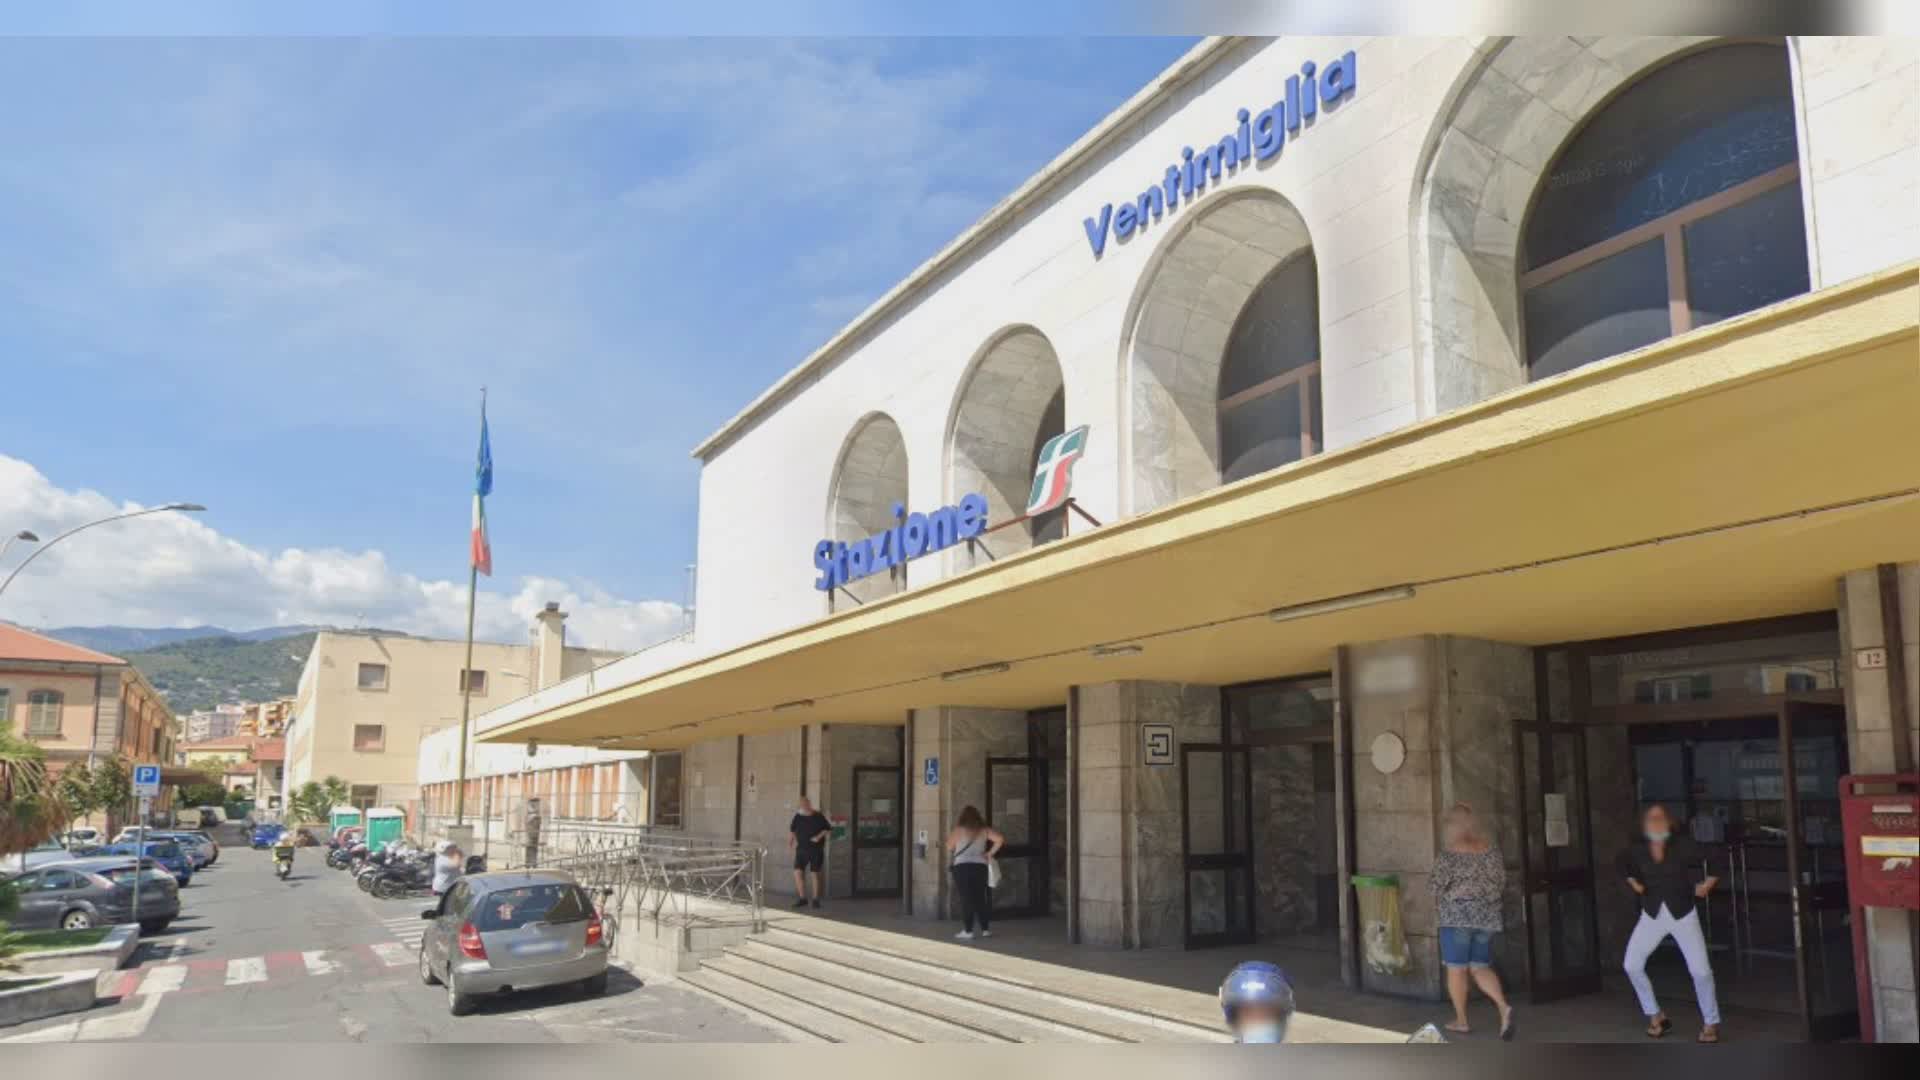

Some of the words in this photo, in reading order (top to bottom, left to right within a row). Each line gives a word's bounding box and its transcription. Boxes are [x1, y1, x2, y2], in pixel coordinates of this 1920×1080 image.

[1083, 50, 1356, 259] Ventimiglia
[814, 493, 988, 591] Stazione
[1863, 653, 1881, 666] 12
[140, 767, 154, 782] P
